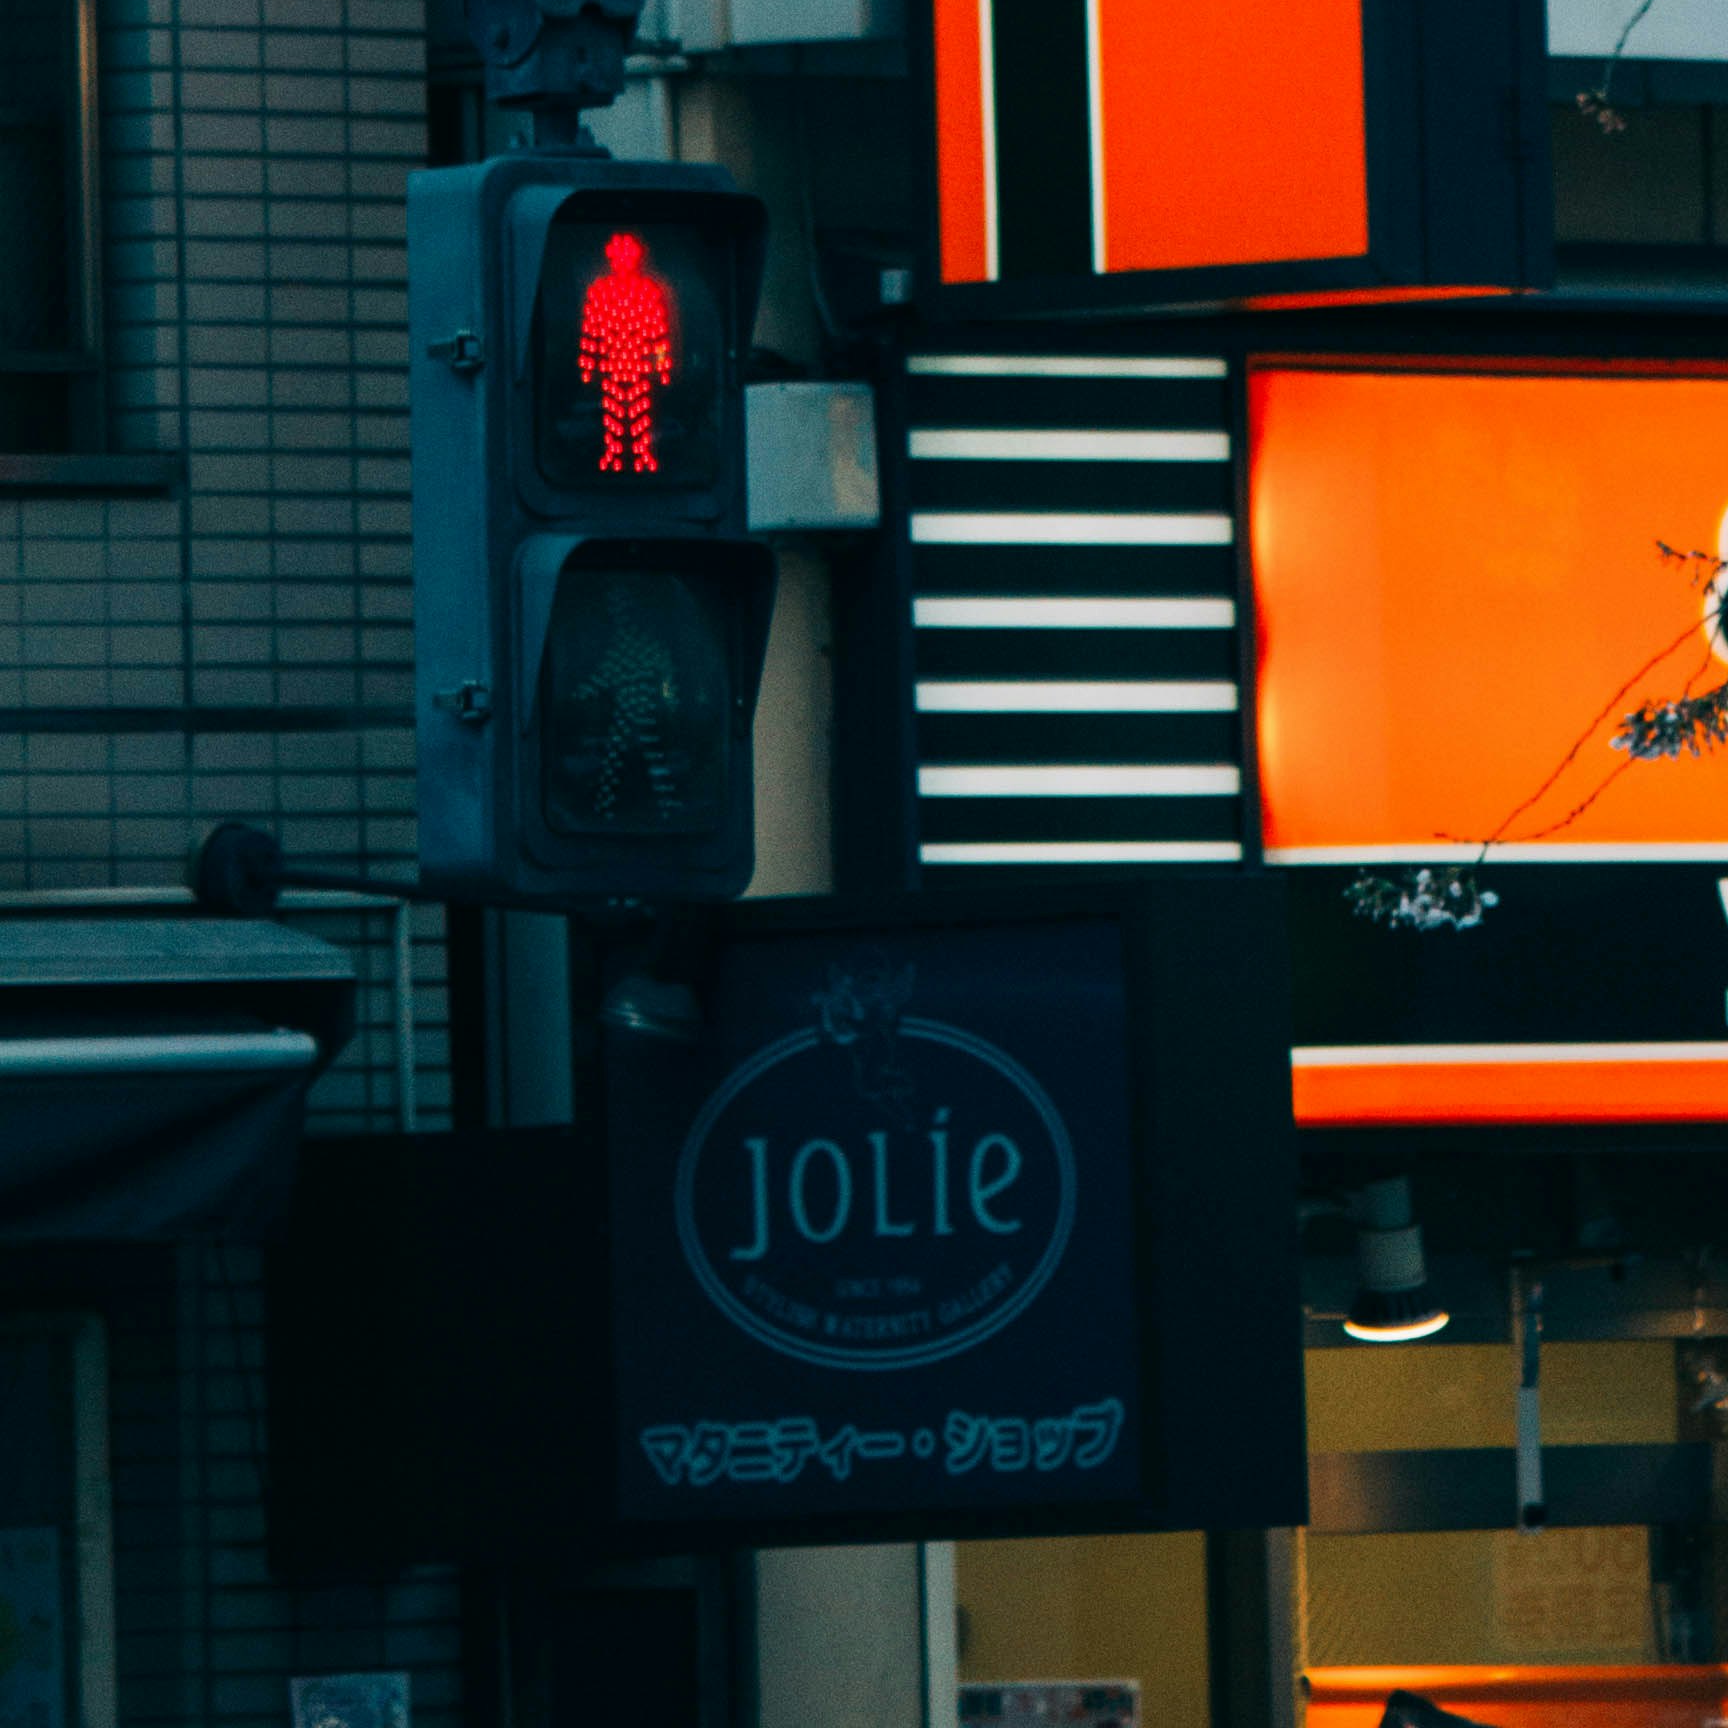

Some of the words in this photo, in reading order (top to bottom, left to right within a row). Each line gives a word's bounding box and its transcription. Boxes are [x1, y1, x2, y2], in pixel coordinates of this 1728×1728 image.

[639, 1397, 1123, 1487] マタニティー・ショップ
